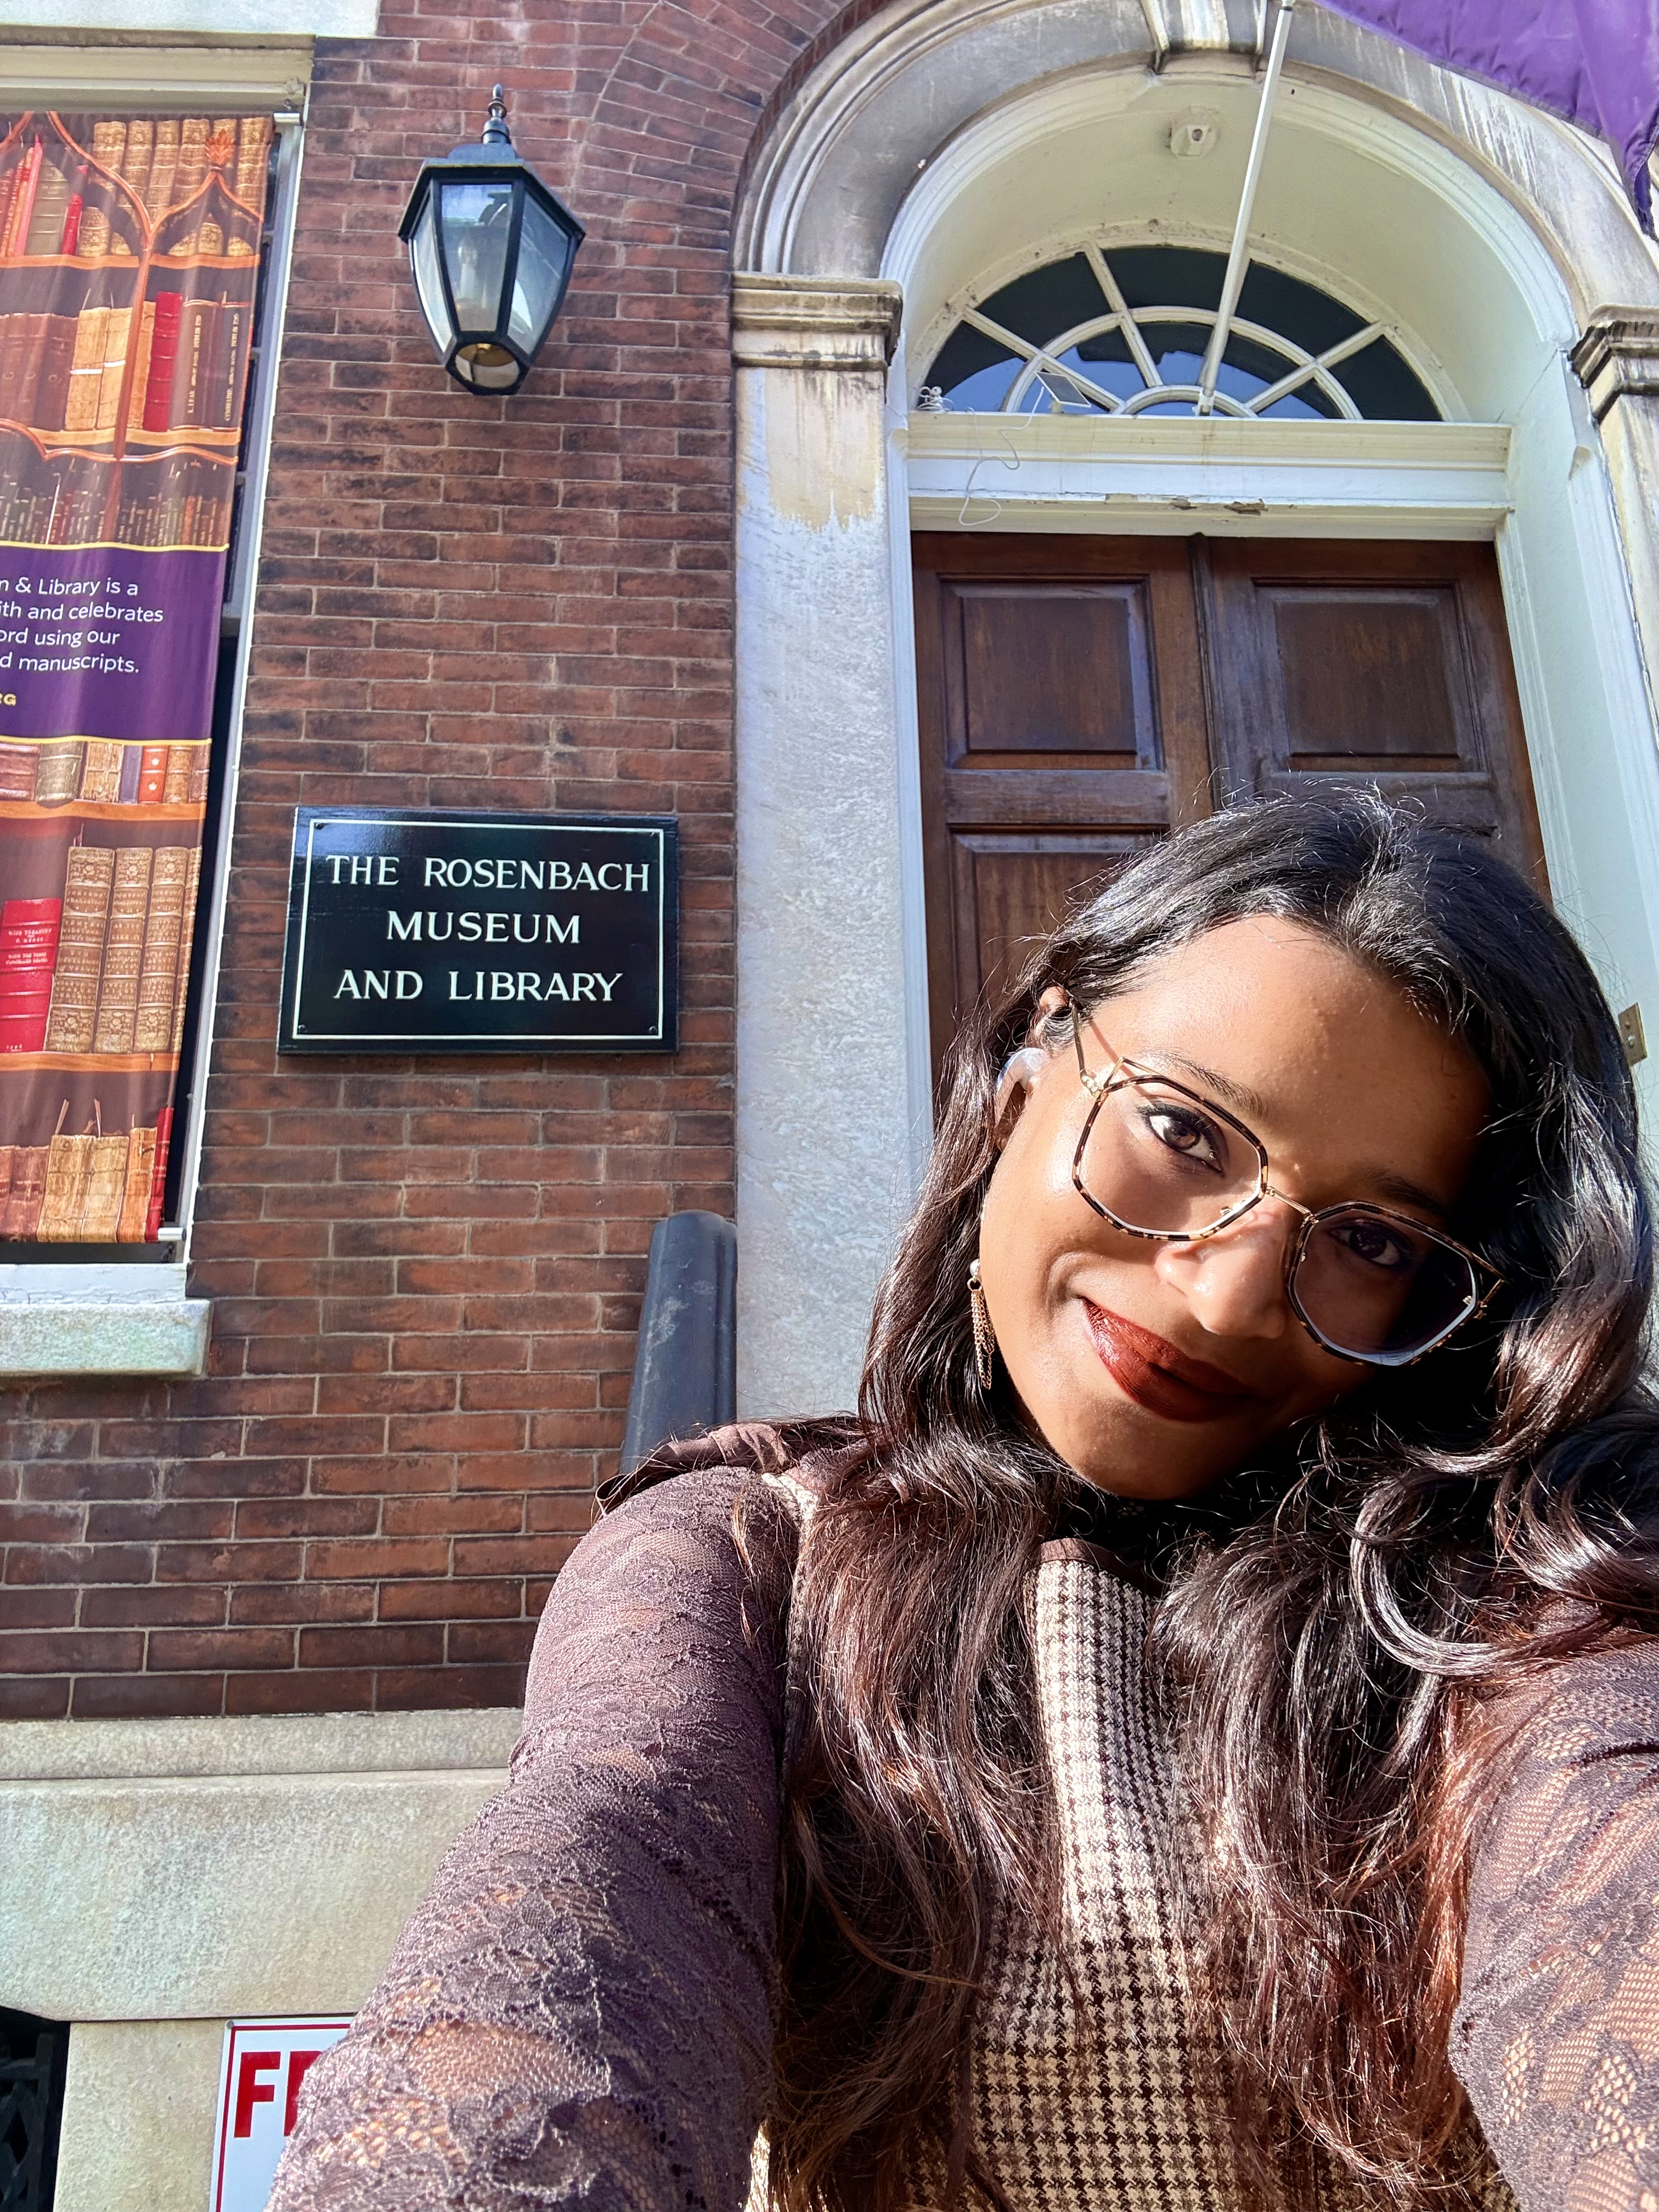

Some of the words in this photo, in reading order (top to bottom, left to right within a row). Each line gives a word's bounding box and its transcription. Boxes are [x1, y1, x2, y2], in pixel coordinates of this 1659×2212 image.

[15, 577, 31, 594] &
[38, 578, 101, 597] Library
[106, 577, 121, 594] is
[127, 584, 138, 596] a
[27, 603, 64, 620] and
[69, 601, 163, 623] celebrates
[35, 629, 83, 648] using
[87, 630, 121, 645] our
[19, 653, 139, 674] manuscripts.
[326, 855, 400, 887] THE
[424, 857, 650, 892] ROSENBACH
[386, 910, 580, 944] MUSEUM
[333, 969, 424, 1000] AND
[449, 971, 623, 1002] LIBRARY
